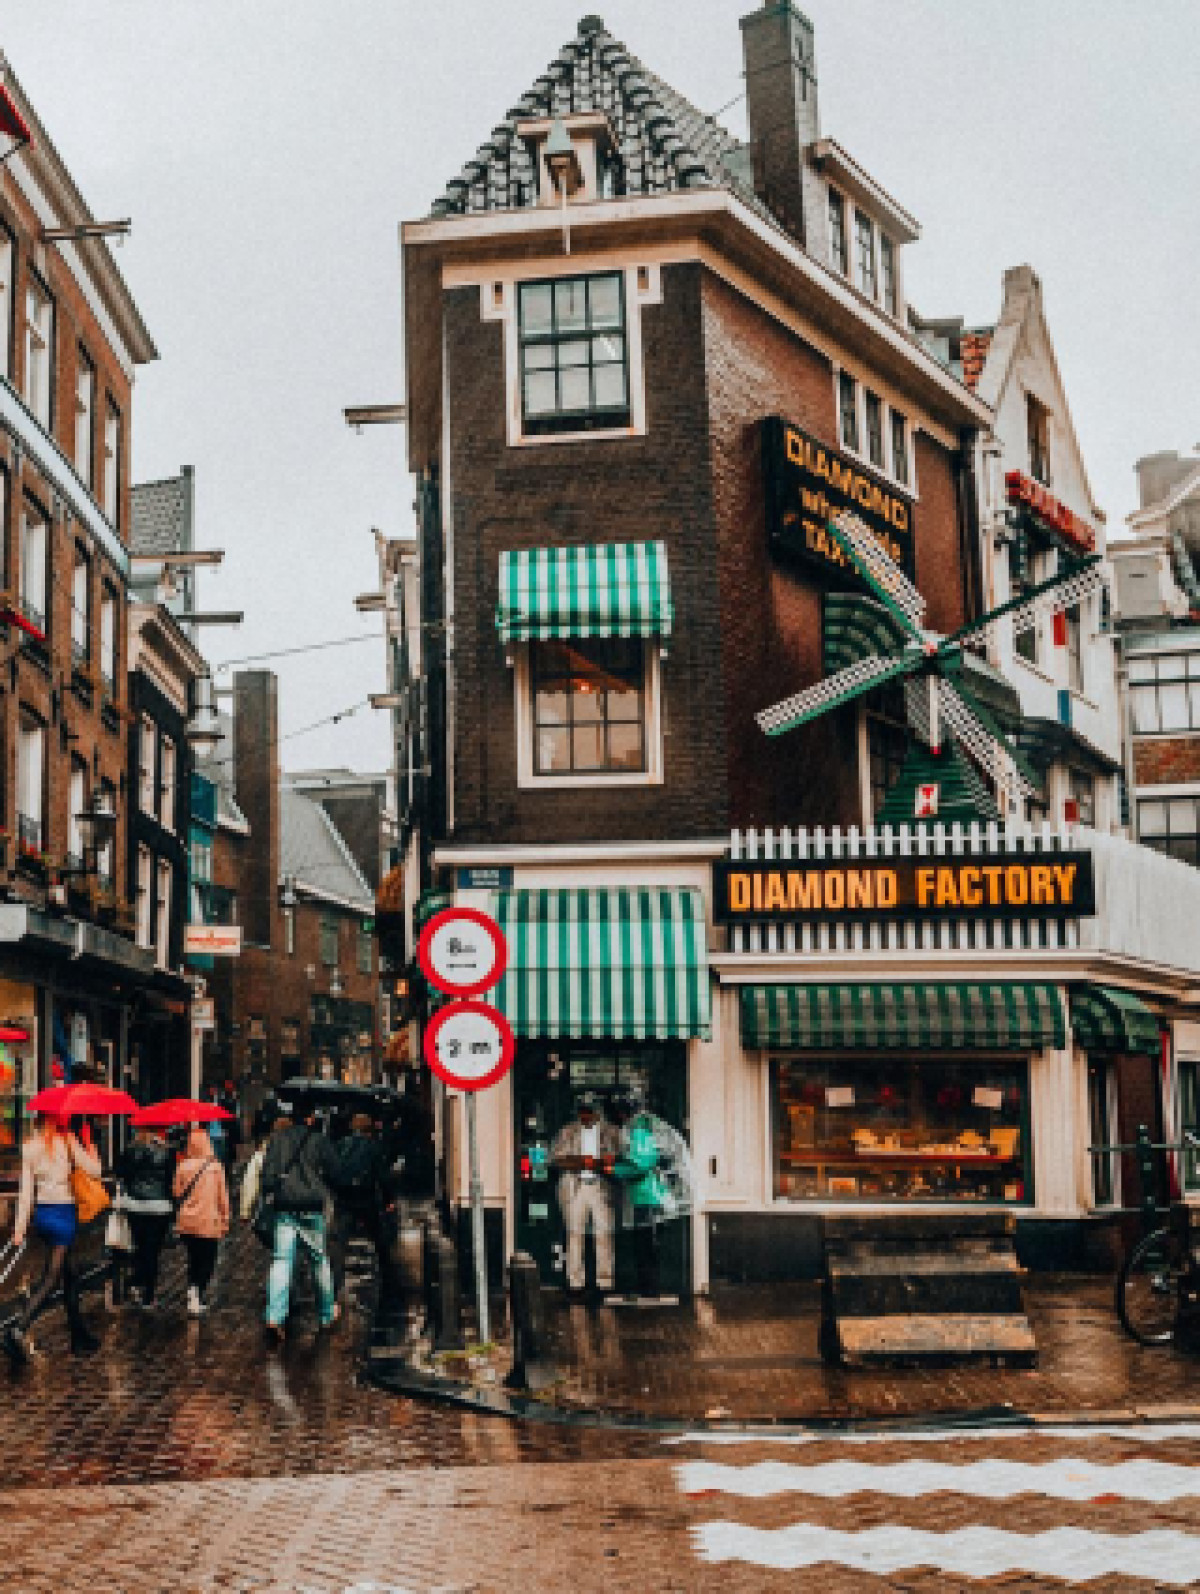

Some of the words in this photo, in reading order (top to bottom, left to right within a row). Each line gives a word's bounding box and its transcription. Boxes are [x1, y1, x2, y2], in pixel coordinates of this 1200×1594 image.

[785, 428, 908, 532] DIAMOND
[727, 868, 898, 912] DIAMOND
[914, 863, 1077, 909] FACTORY
